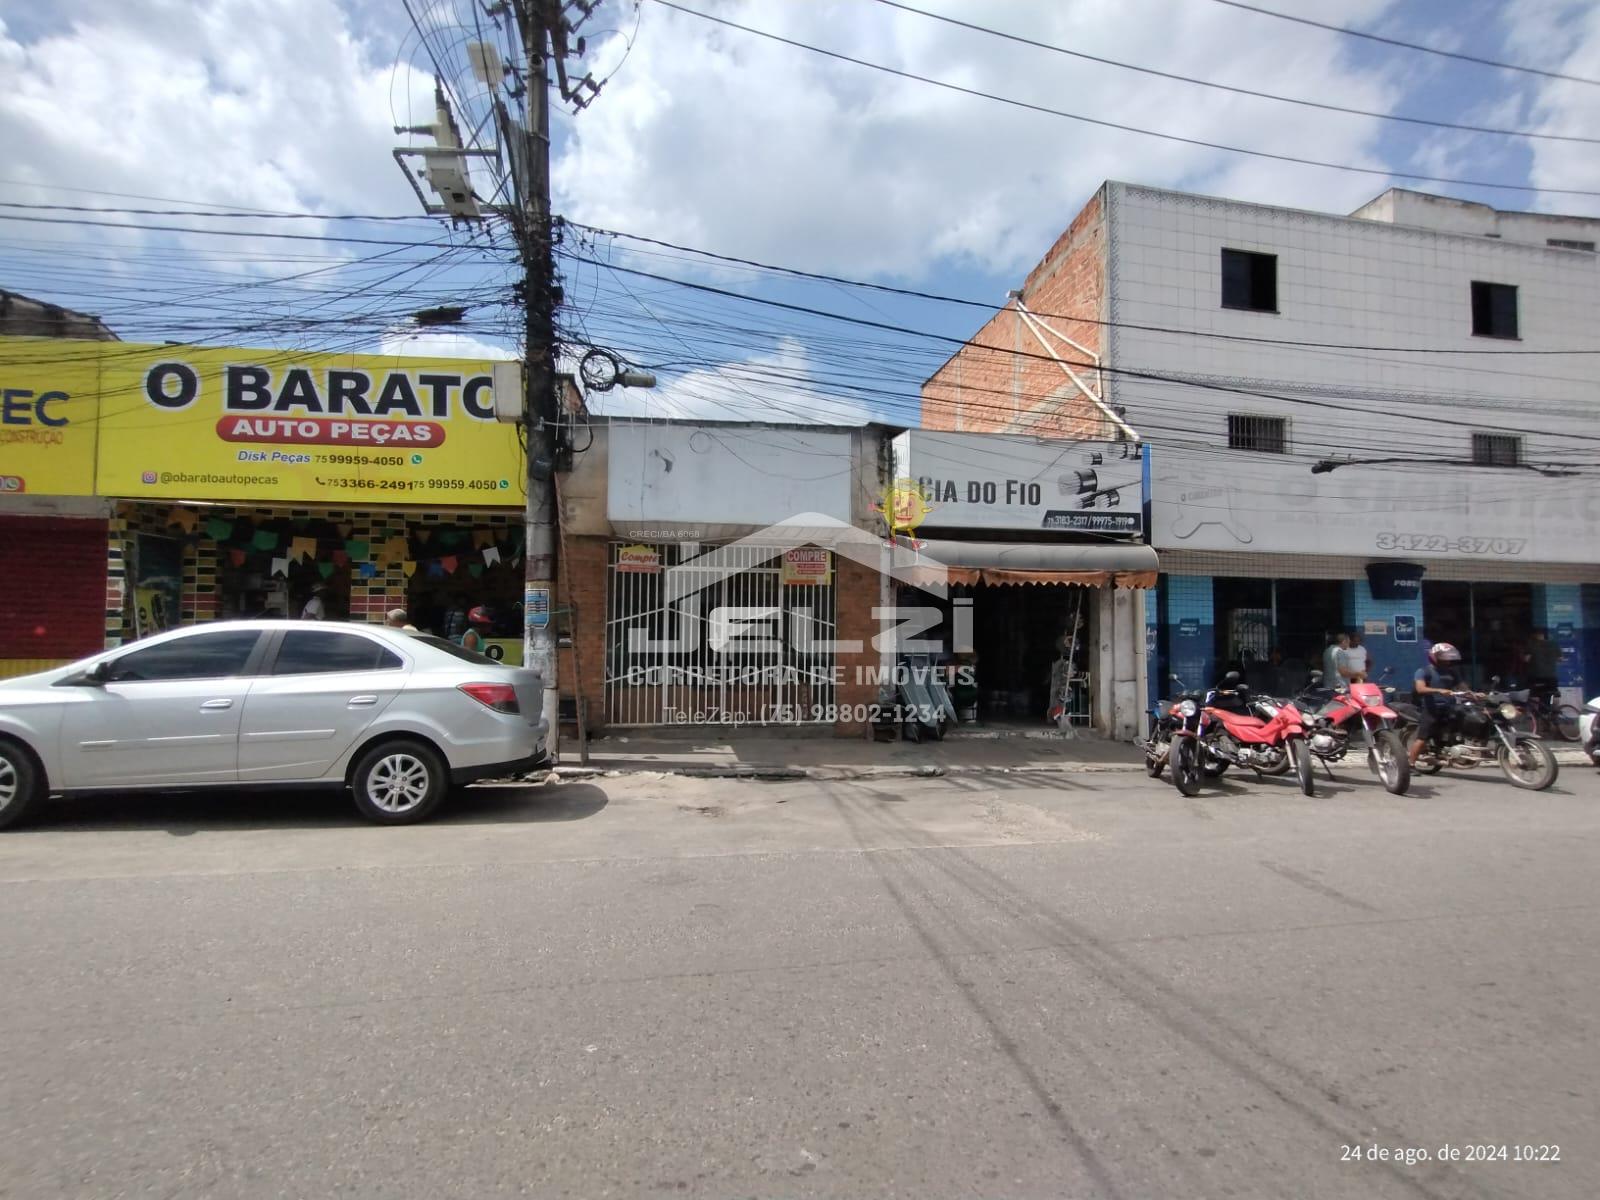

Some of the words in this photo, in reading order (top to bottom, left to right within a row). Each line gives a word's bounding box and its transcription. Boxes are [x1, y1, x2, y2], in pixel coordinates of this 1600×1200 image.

[147, 363, 198, 407] O
[227, 366, 495, 418] BARATO
[0, 389, 70, 427] EC
[232, 419, 320, 438] AUTO
[331, 422, 432, 443] PEÇAS
[237, 451, 267, 463] Disk
[272, 453, 311, 465] Peças
[329, 455, 404, 466] 99959-4050
[160, 472, 279, 486] @obaratoautopecas
[340, 479, 413, 490] 3366-2491
[919, 476, 958, 502] CIA
[967, 481, 996, 504] DO
[1006, 480, 1041, 506] FIO
[1376, 532, 1528, 554] 3422-3707
[787, 551, 827, 562] COMPRE
